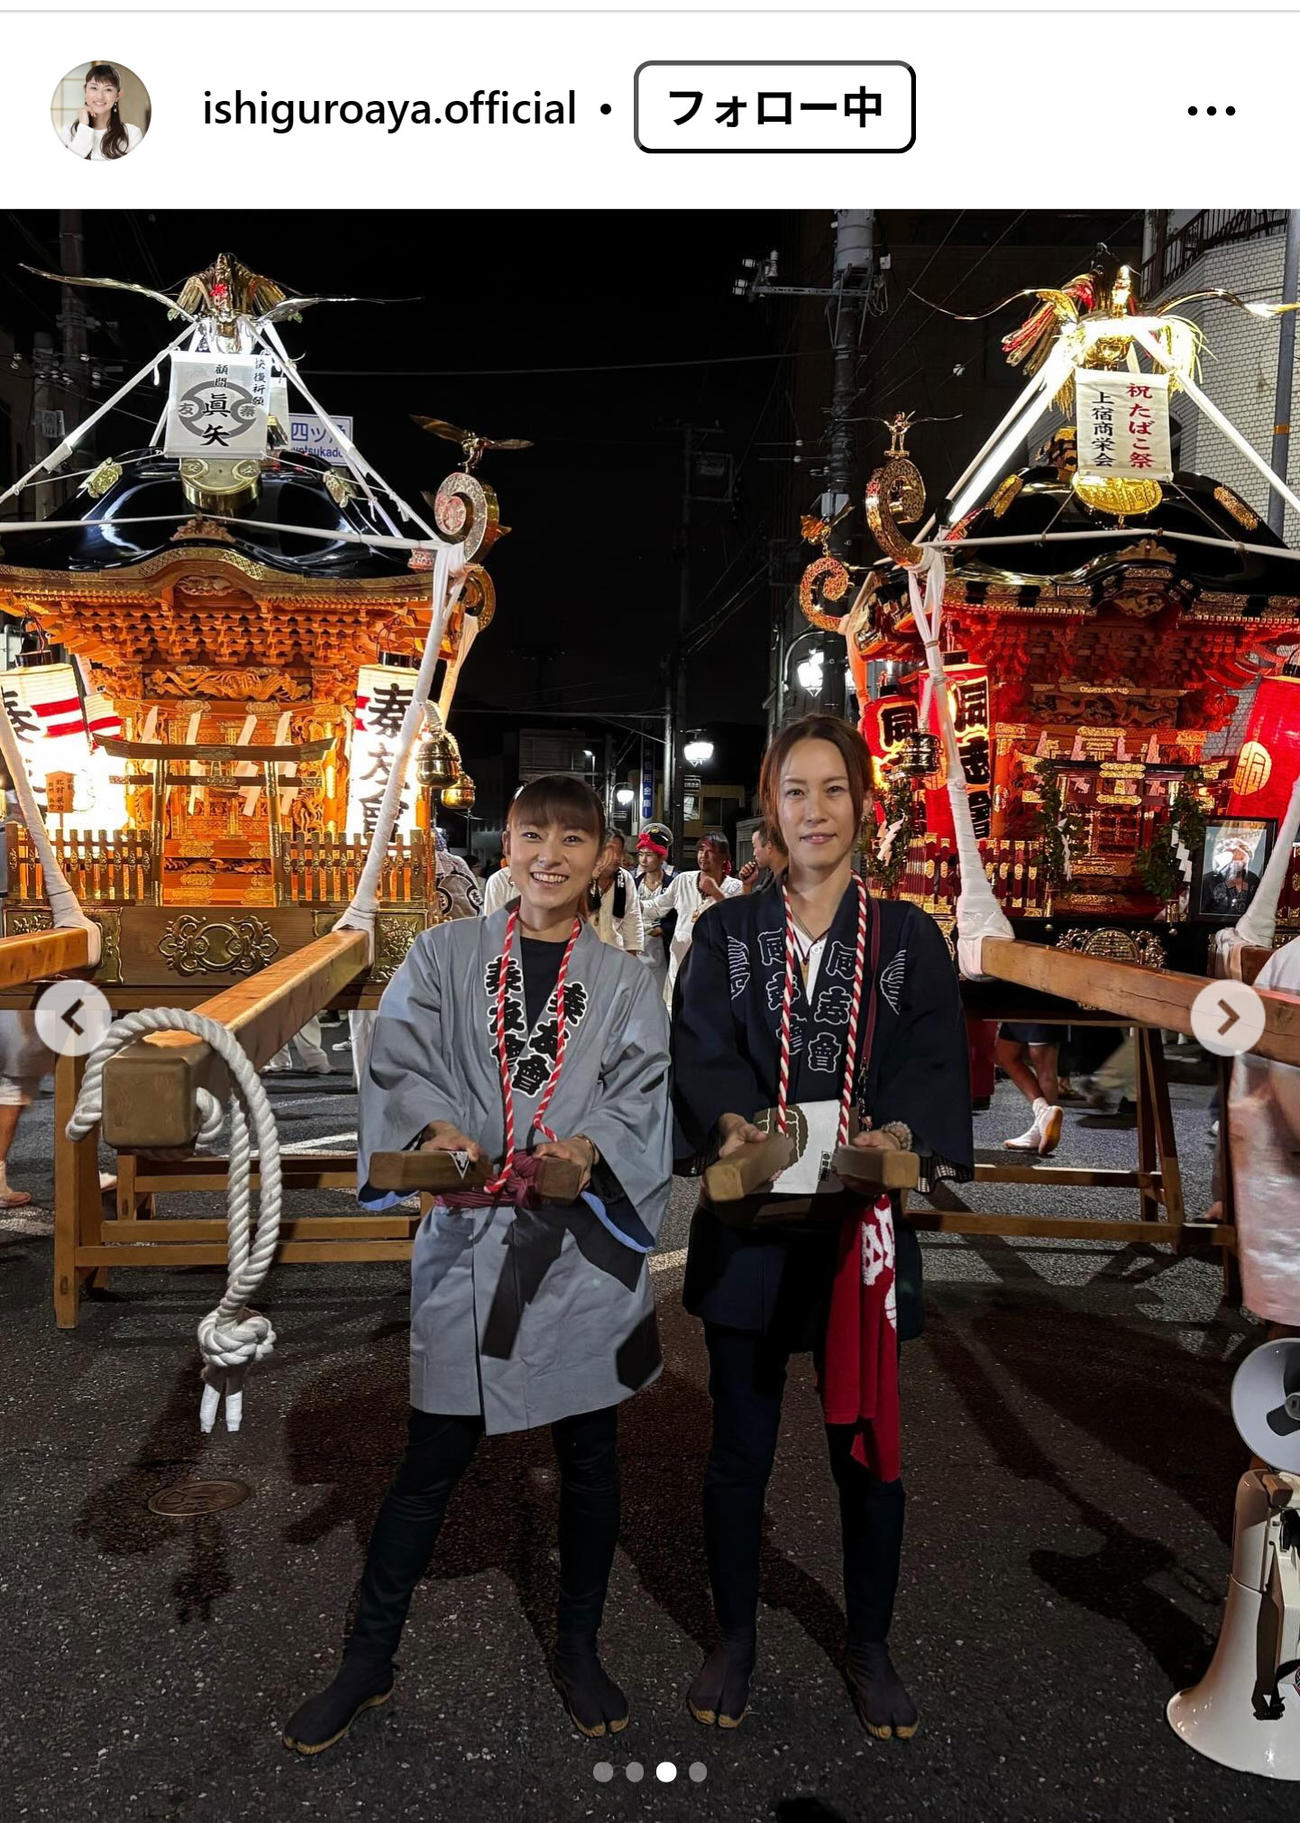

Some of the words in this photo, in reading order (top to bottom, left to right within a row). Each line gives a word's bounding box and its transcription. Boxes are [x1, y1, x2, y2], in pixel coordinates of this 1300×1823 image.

[1091, 391, 1116, 468] 上宿商栄会
